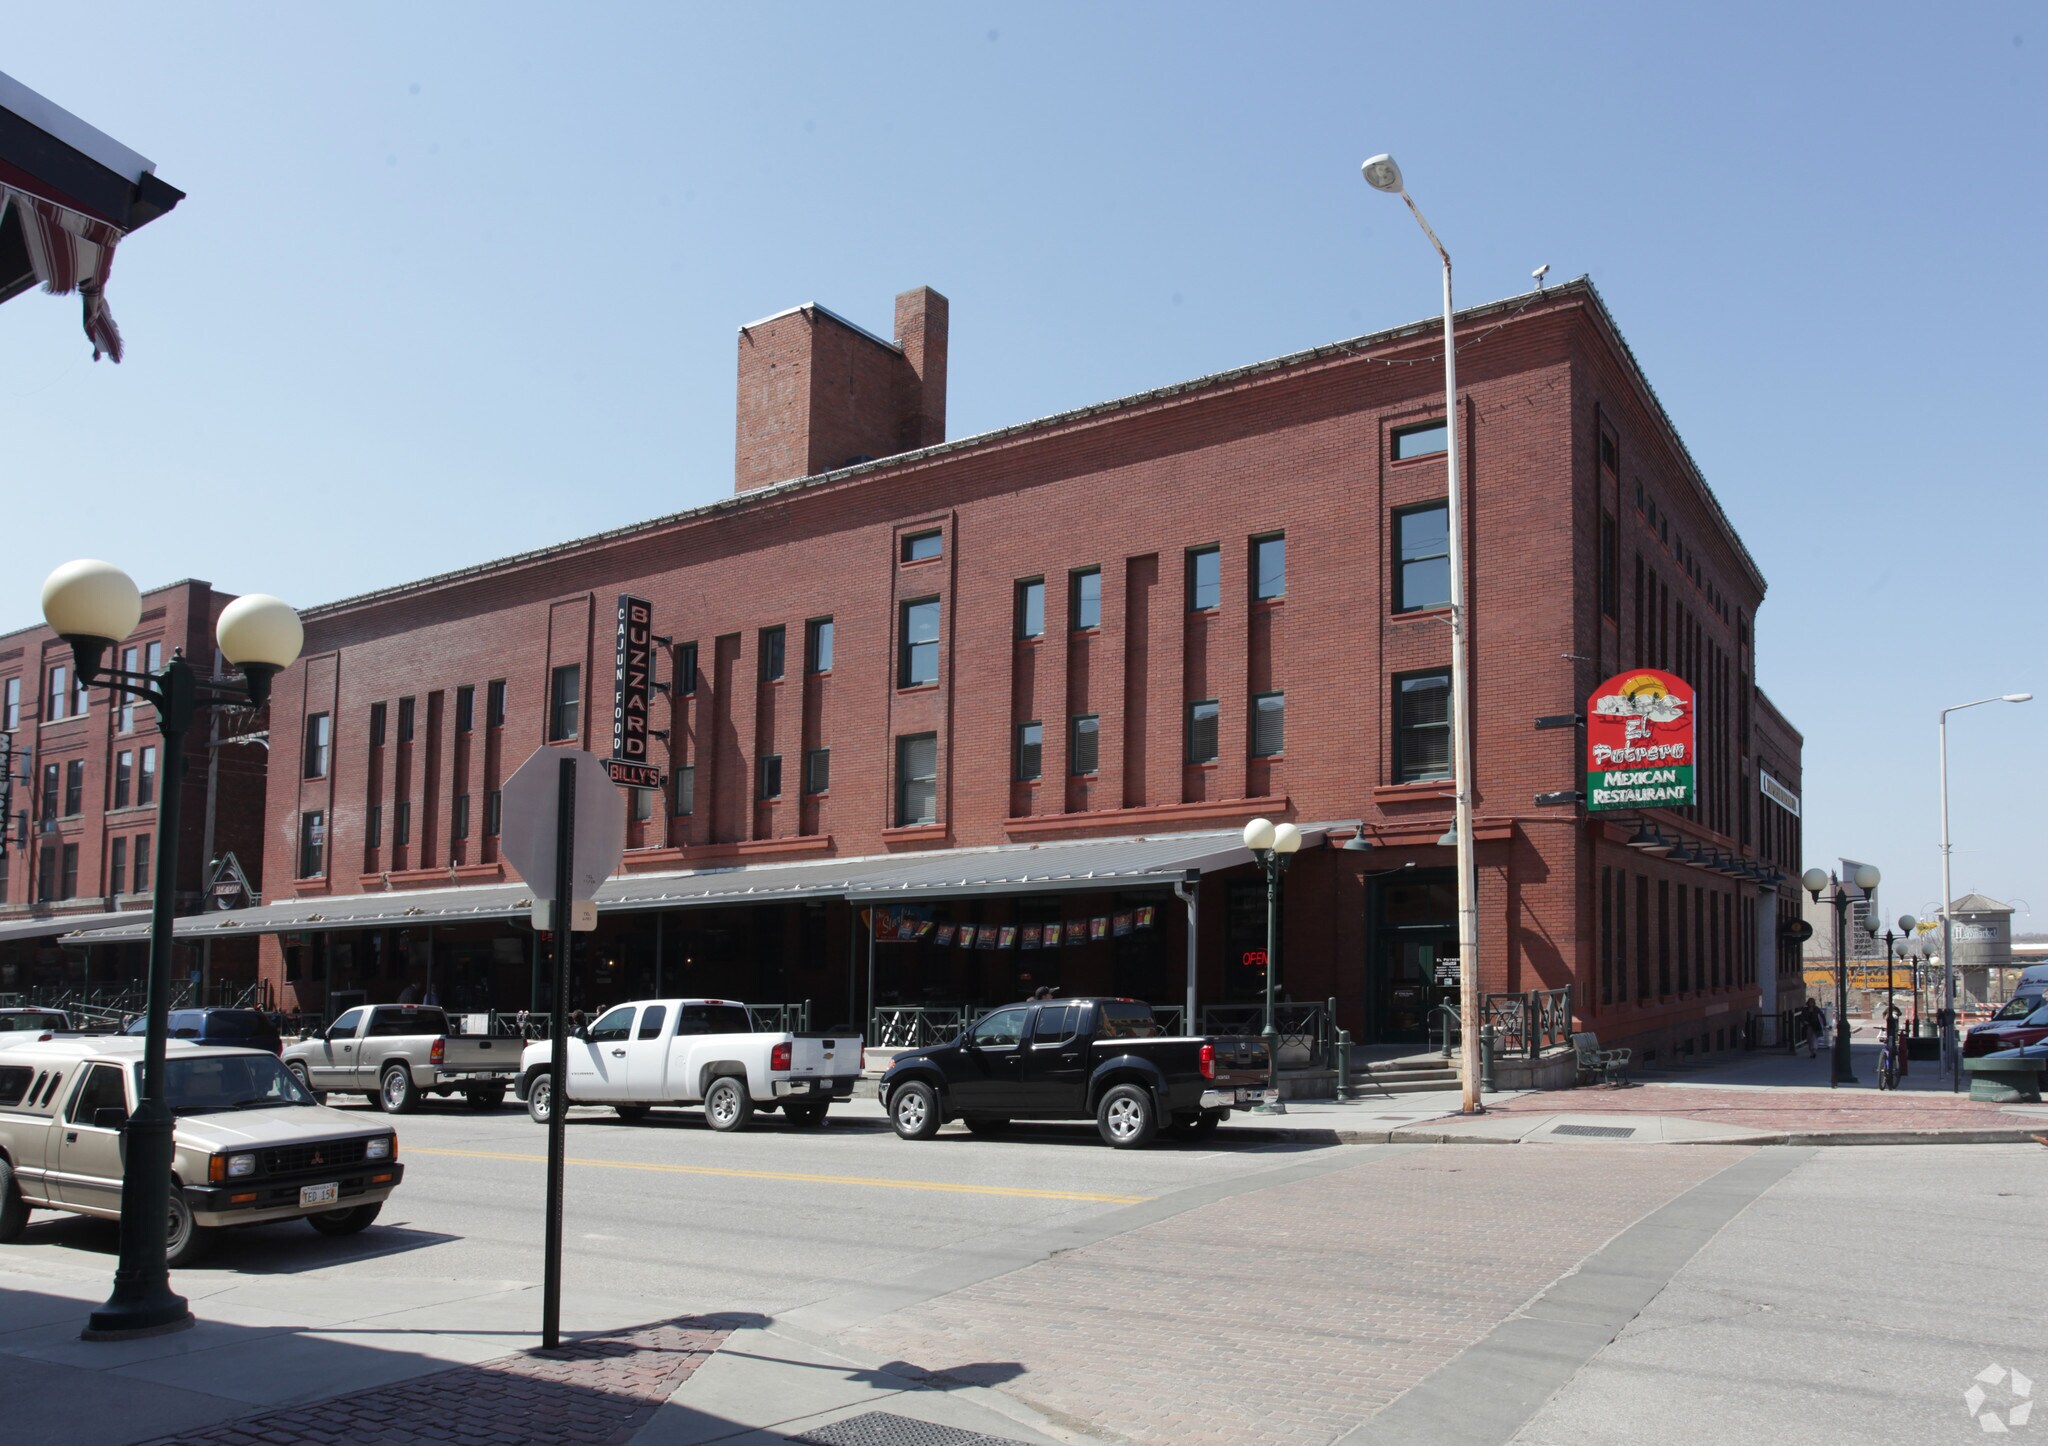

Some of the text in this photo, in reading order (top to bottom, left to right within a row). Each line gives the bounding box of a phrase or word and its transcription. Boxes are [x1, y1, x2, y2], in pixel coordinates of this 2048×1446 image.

[614, 608, 625, 750] CAJUN FOOD
[626, 605, 648, 755] BUZZARD
[1625, 712, 1651, 740] El
[610, 764, 658, 786] BILLY'S
[1603, 770, 1677, 787] MEXICAN
[1593, 786, 1687, 804] RESTAURANT
[1242, 951, 1269, 966] OPEN
[304, 1190, 317, 1203] TED
